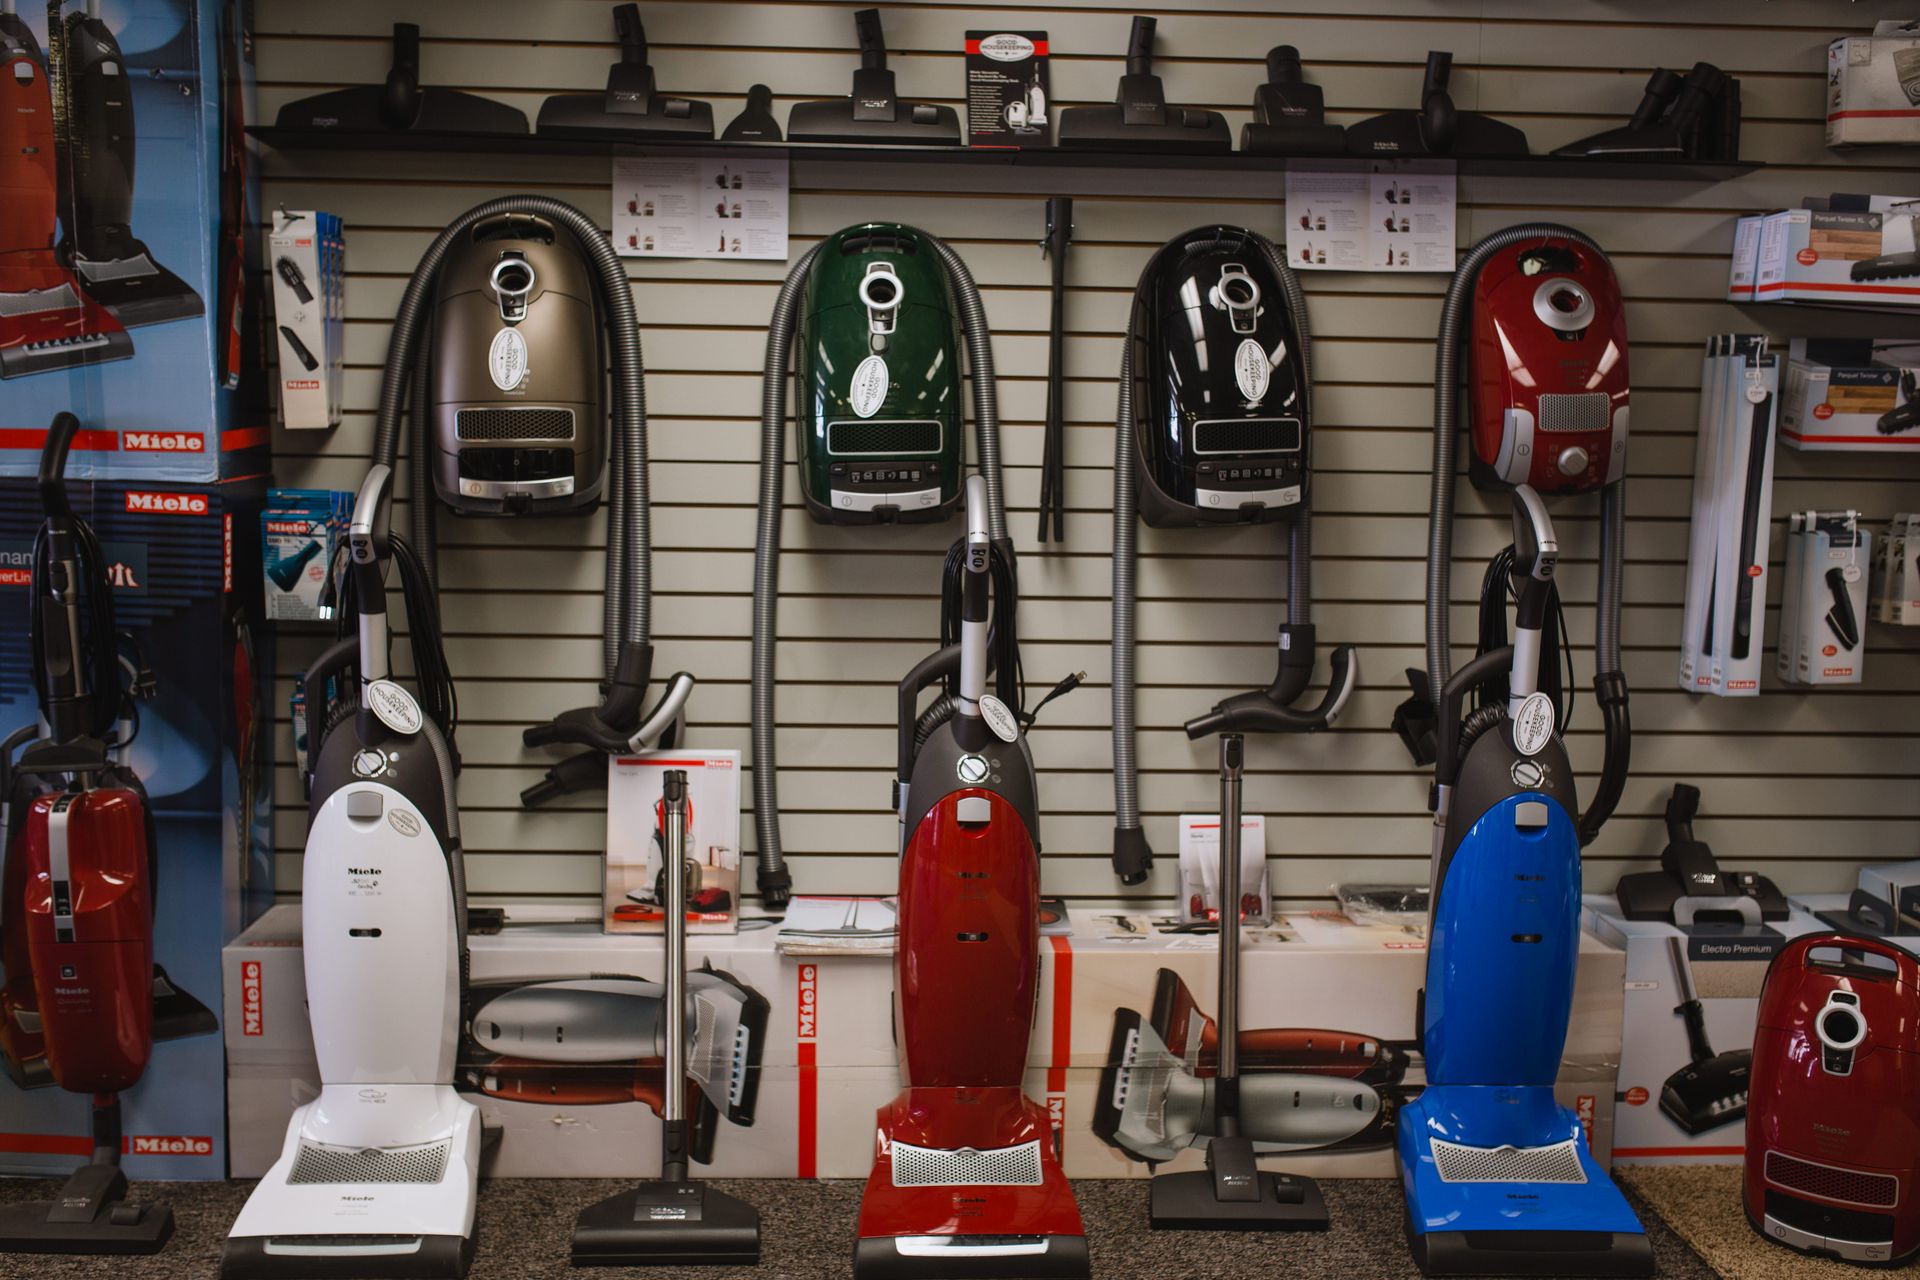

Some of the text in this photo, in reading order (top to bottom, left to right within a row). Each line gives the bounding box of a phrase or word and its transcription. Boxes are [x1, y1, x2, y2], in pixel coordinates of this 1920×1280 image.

[125, 433, 202, 450] Miele
[128, 494, 205, 512] Miele
[266, 522, 307, 532] Miele
[347, 867, 382, 875] Miele
[1701, 944, 1771, 953] Electro Premium
[245, 963, 260, 1034] Miele
[800, 966, 815, 1036] Miele
[135, 1137, 209, 1153] Miele
